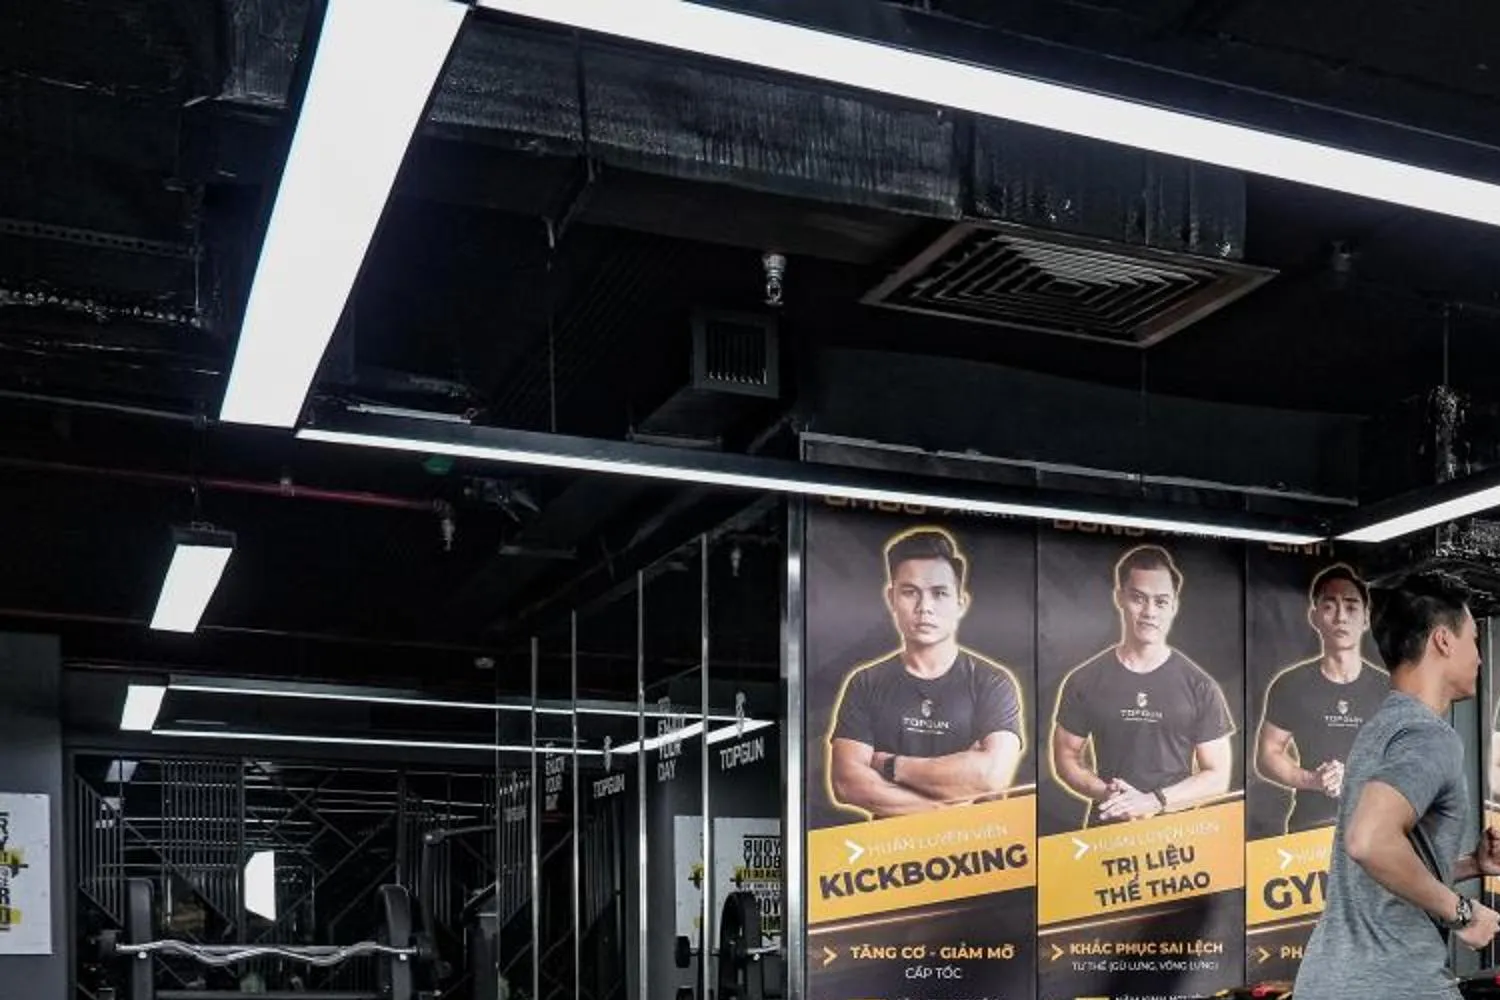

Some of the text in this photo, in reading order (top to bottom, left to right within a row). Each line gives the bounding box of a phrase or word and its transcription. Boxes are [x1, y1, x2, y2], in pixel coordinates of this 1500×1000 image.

[819, 843, 1028, 899] KICKBOXING
[1102, 844, 1195, 880] TRỊ LIỆU
[1095, 871, 1211, 907] THỂ THAO
[850, 942, 897, 959] TĂNG
[900, 945, 926, 959] CƠ
[940, 941, 982, 960] GIẢM
[988, 943, 1015, 959] MỠ
[1069, 938, 1223, 957] KHÁC PHỤC SAI LỆCH
[905, 965, 962, 979] CẤP TỐC
